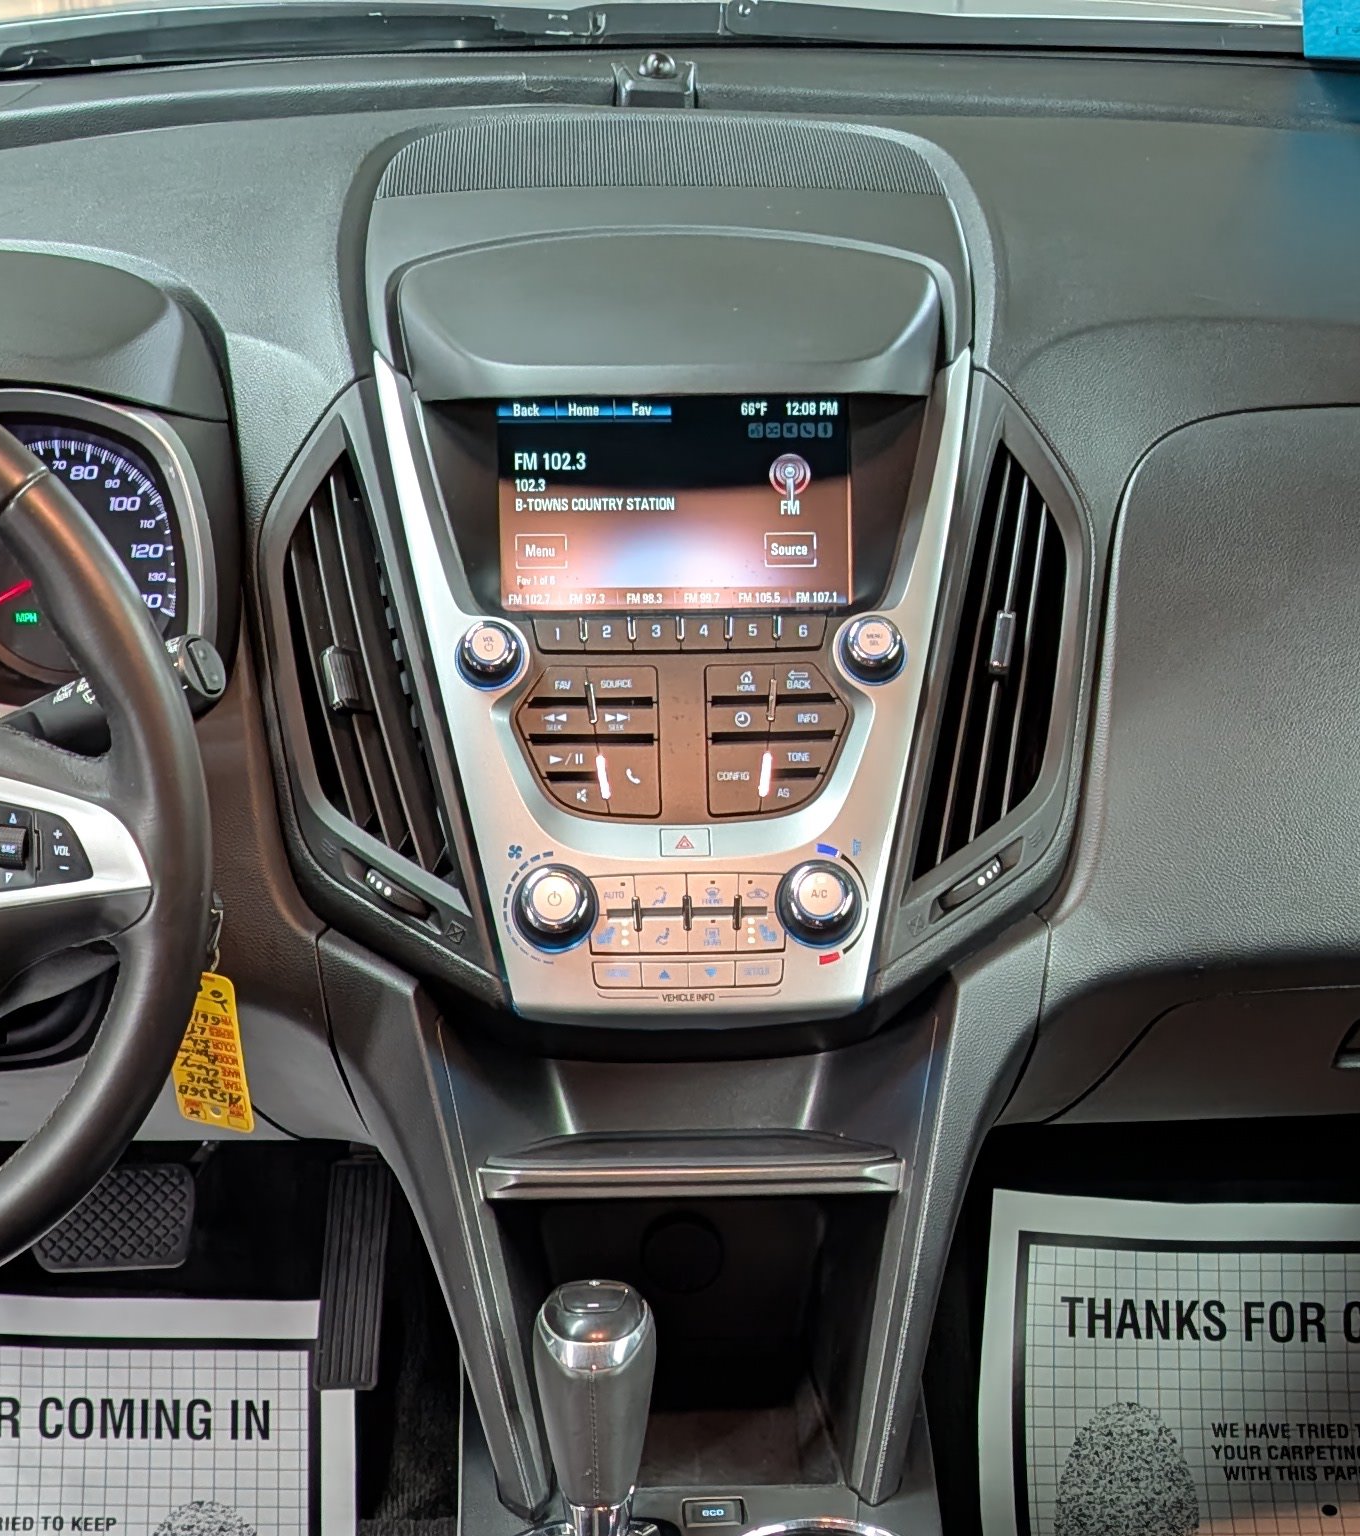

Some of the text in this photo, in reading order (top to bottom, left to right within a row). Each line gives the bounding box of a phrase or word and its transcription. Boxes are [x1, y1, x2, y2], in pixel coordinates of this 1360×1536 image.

[513, 403, 540, 417] Back
[568, 402, 600, 417] Home
[631, 402, 652, 416] Fav
[785, 401, 838, 416] 12:08 PM
[52, 460, 67, 470] 70
[514, 452, 587, 471] FM 102.3
[70, 466, 98, 481] 80
[515, 479, 546, 492] 102.3
[109, 497, 141, 511] 100
[515, 497, 675, 512] B-TOWNS COUNTRY STATION
[780, 500, 800, 515] FM
[131, 544, 164, 558] 120
[525, 544, 555, 557] Menu
[770, 543, 808, 556] Source
[626, 593, 663, 604] FM 98.3
[738, 593, 752, 603] FM
[796, 592, 838, 603] FM 107.1
[15, 612, 38, 622] MPH
[555, 628, 560, 641] 1
[602, 625, 612, 638] 2
[651, 624, 661, 638] 3
[699, 624, 709, 638] 4
[748, 623, 758, 637] 5
[798, 624, 808, 638] 6
[554, 680, 571, 690] FAV
[600, 679, 632, 688] SOURCE
[786, 680, 811, 689] BACK
[797, 713, 818, 724] INFO
[787, 752, 810, 762] TONE
[716, 771, 750, 781] CONFIG
[777, 787, 790, 798] AS
[53, 845, 70, 857] VOL
[603, 891, 625, 899] AUTO
[811, 887, 828, 899] A/C
[661, 993, 715, 1002] VEHICLE INFO
[1061, 1296, 1227, 1341] THANKS
[1243, 1300, 1327, 1343] FOR
[39, 1397, 213, 1440] COMING
[230, 1399, 271, 1441] IN
[1211, 1423, 1239, 1438] WE
[1245, 1423, 1290, 1439] HAVE
[1295, 1423, 1349, 1439] TRIED
[1211, 1445, 1261, 1460] YOUR
[1223, 1466, 1271, 1481] WITH
[1275, 1466, 1317, 1481] THIS
[702, 1508, 725, 1517] eco
[41, 1516, 64, 1531] TO
[71, 1516, 117, 1532] KEEP
